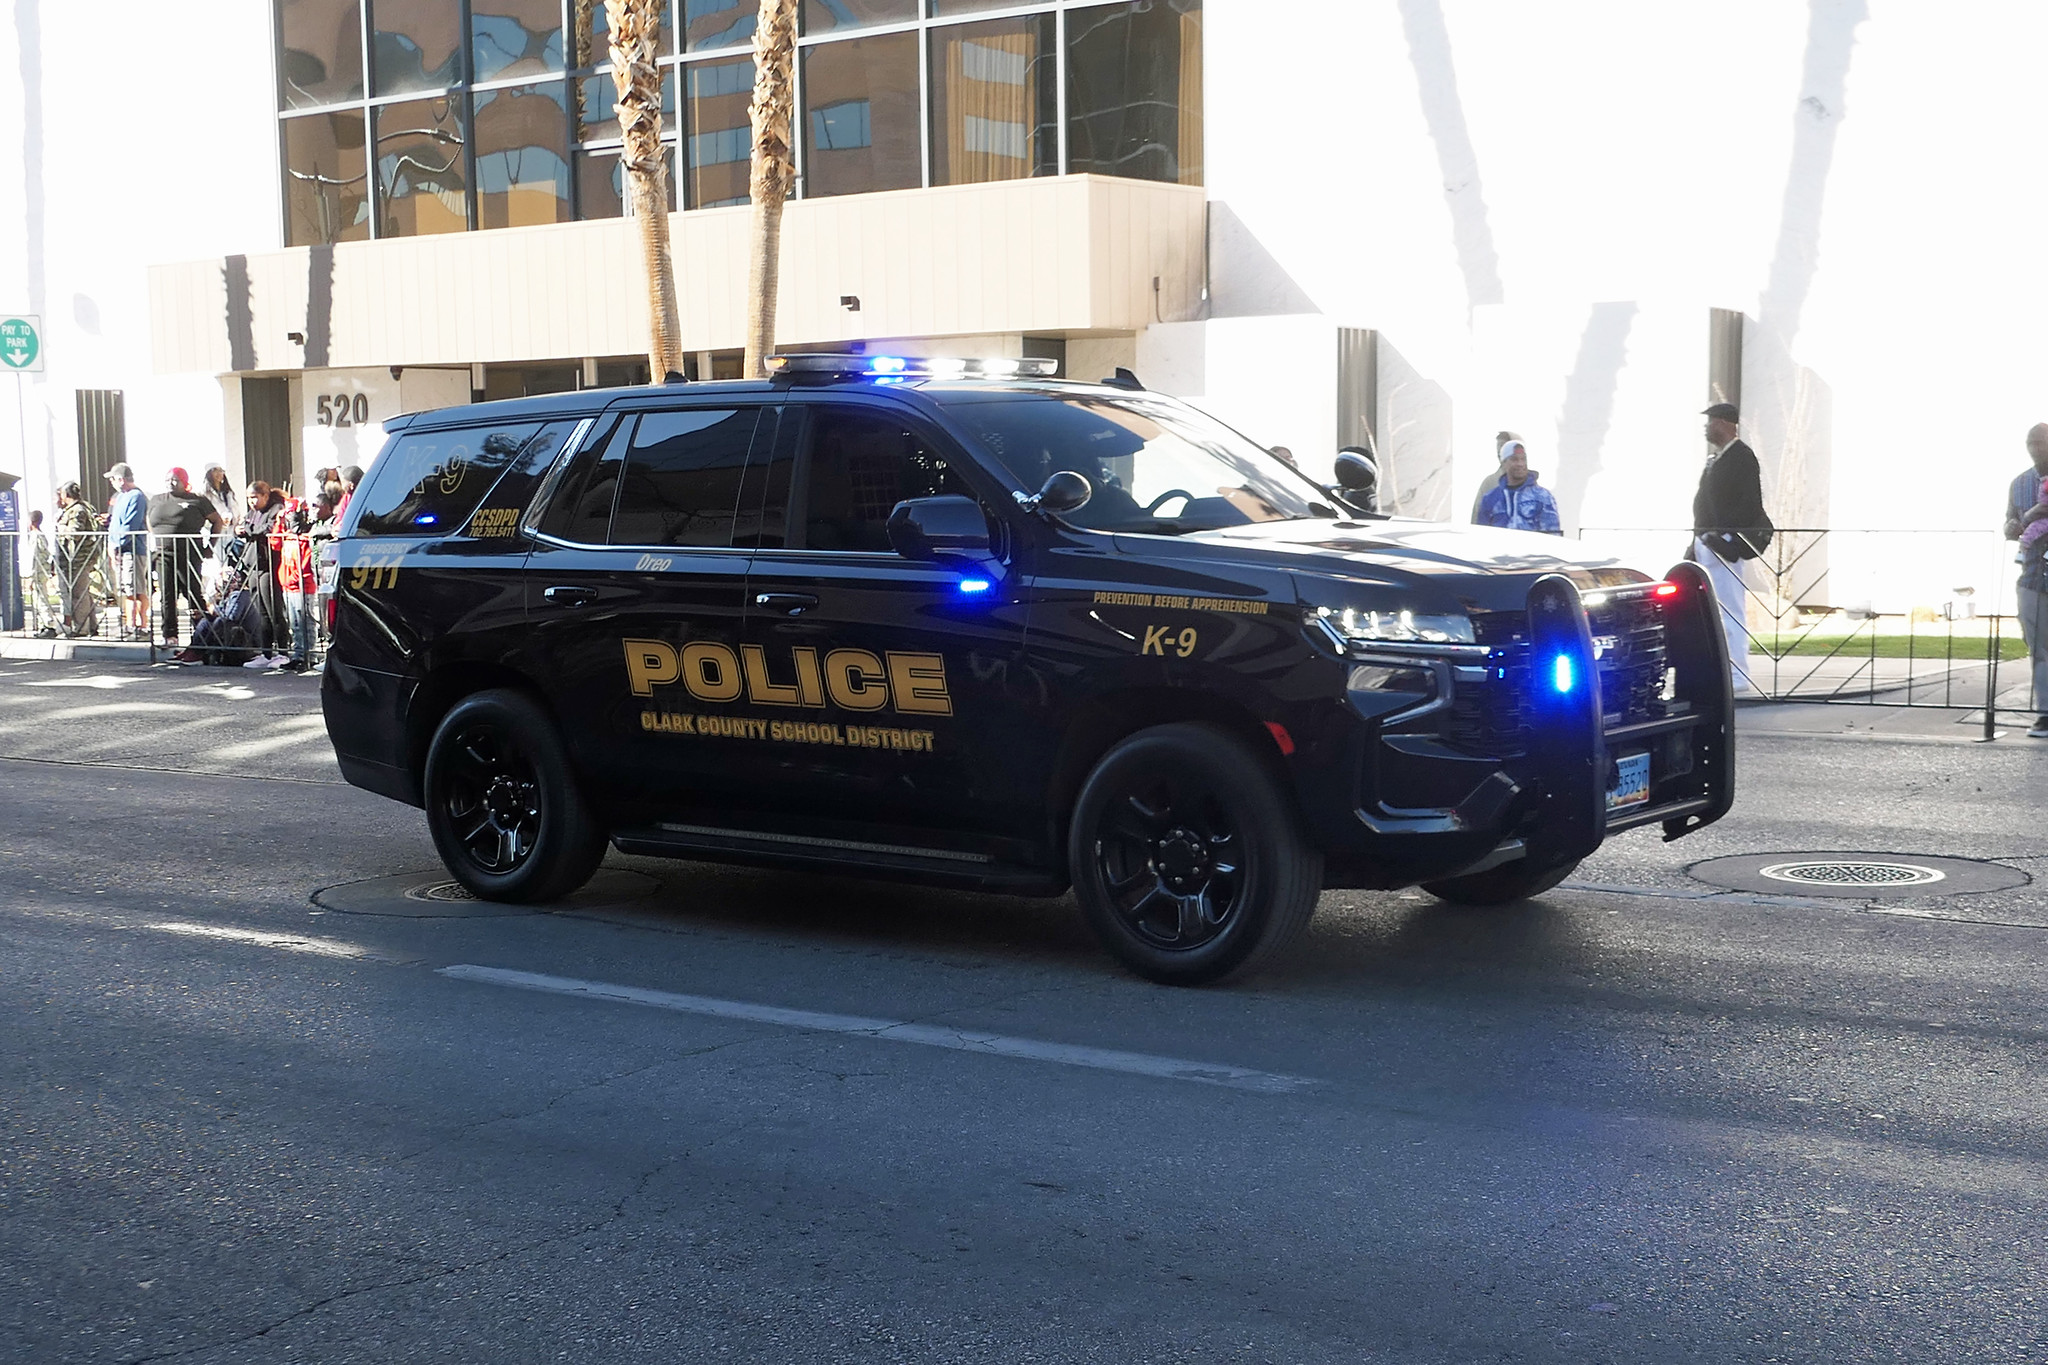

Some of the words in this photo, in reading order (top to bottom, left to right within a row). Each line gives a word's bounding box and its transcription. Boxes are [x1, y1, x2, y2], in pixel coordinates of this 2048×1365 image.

[1, 325, 16, 336] PAY
[20, 325, 31, 336] TO
[6, 337, 28, 348] PARK
[317, 393, 369, 428] 520
[397, 444, 469, 494] K-9
[471, 508, 520, 527] CCSDPD
[351, 555, 405, 590] 911
[635, 553, 672, 571] Oreo
[1093, 591, 1152, 607] PREVENTION
[1154, 595, 1190, 610] BEFORE
[1191, 597, 1269, 615] APPREHENSION
[1142, 624, 1197, 658] K-9
[622, 637, 954, 716] POLICE
[640, 710, 697, 735] CLARK
[697, 714, 768, 740] COUNTY
[770, 720, 845, 746] SCHOOL
[846, 725, 935, 752] DISTRICT
